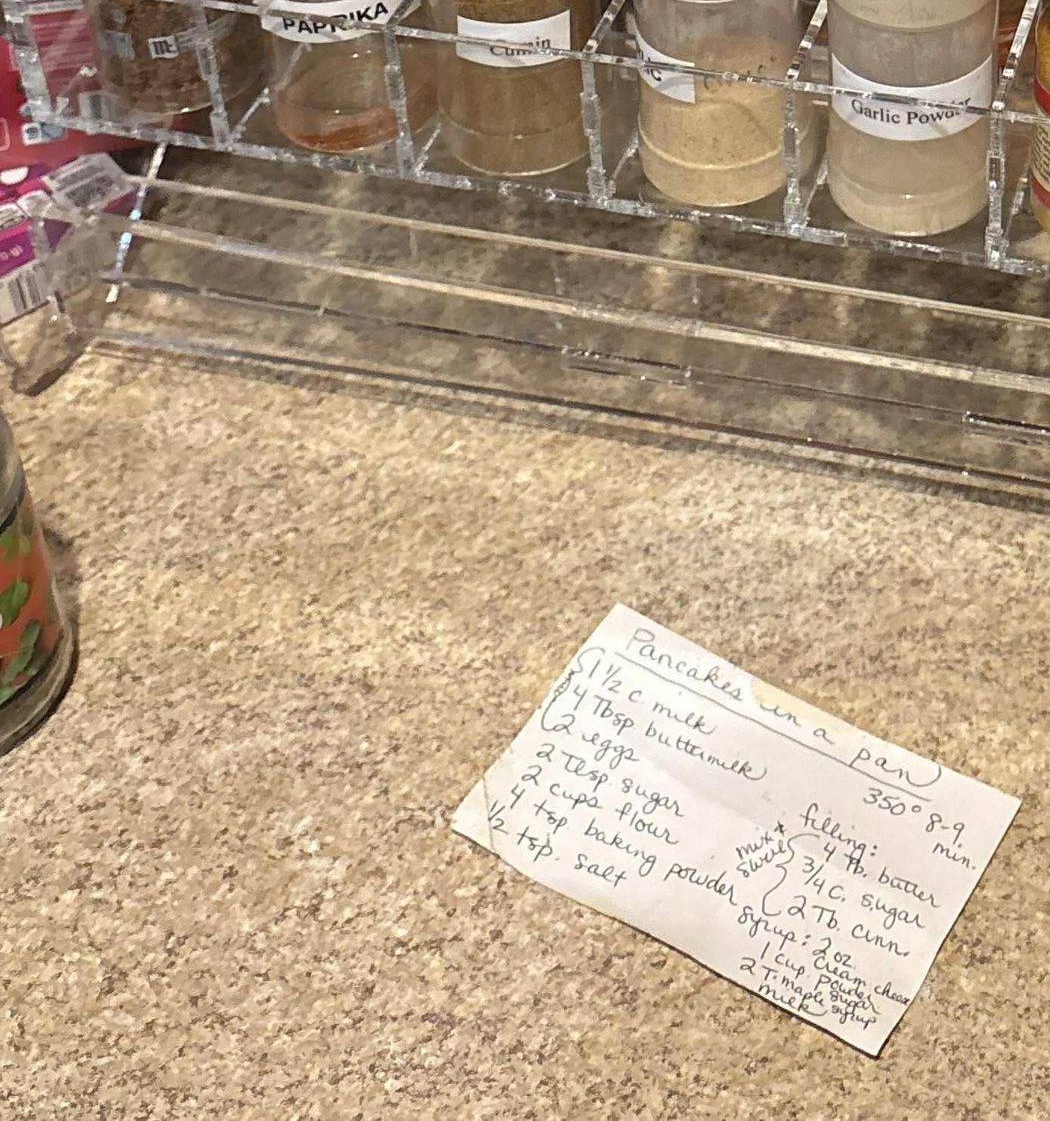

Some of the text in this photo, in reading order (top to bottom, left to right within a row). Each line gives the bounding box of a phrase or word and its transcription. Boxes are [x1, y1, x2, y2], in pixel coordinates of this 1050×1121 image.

[851, 99, 900, 124] Garlic
[626, 628, 942, 787] Pancakes in a pan
[652, 701, 716, 735] milk
[554, 714, 640, 770] 2 eggs
[573, 684, 588, 711] 4
[645, 722, 768, 781] buttermilk
[537, 743, 555, 763] 2
[622, 778, 684, 818] sugar
[522, 765, 679, 845] 2 cups flour
[510, 783, 526, 809] 4
[584, 818, 657, 877] baking
[663, 863, 737, 906] powder
[574, 854, 627, 888] salt
[824, 842, 836, 863] 4
[878, 866, 941, 908] butter
[787, 895, 806, 919] 2
[861, 894, 925, 930] sugar
[760, 941, 771, 960] 1
[813, 938, 832, 957] 2
[739, 957, 756, 976] 2
